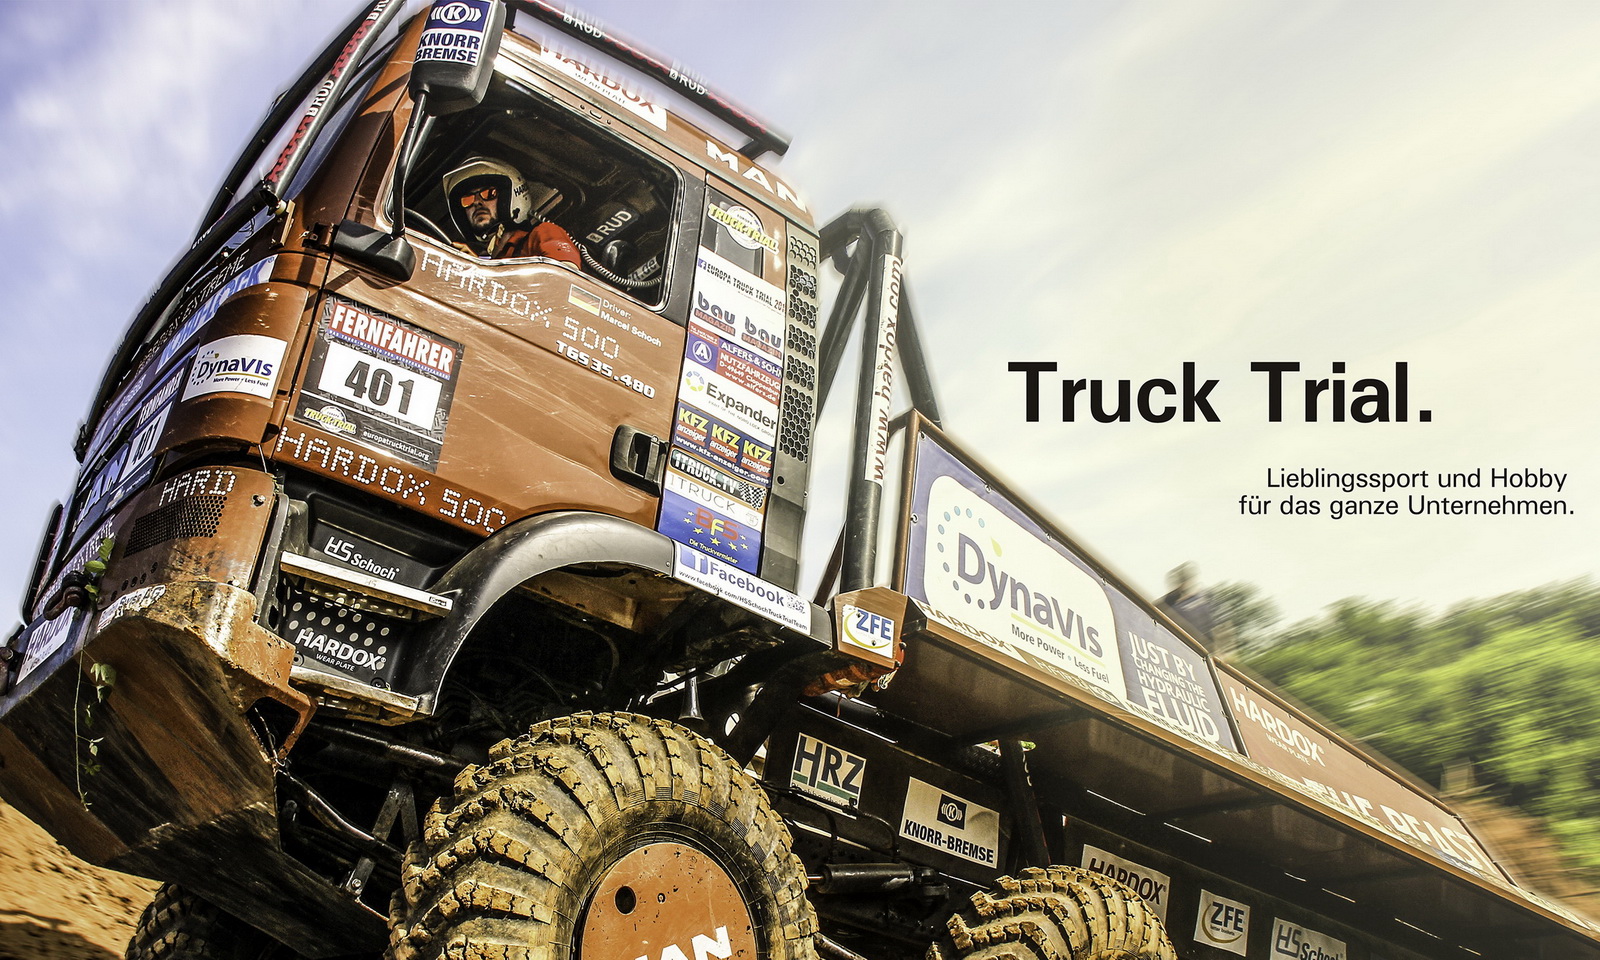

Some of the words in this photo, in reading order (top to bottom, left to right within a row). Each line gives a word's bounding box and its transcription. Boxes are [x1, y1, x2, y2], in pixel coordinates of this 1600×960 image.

[415, 48, 478, 63] BREMSE
[419, 33, 481, 50] KNORR
[313, 79, 335, 108] RUD
[678, 73, 705, 95] RUD
[705, 139, 807, 214] MAN
[596, 210, 632, 236] RUD
[420, 250, 553, 329] HARDOX
[562, 316, 620, 360] 500
[602, 299, 632, 319] Driver:
[694, 307, 736, 337] MAGAZIN
[698, 291, 736, 325] bau
[331, 304, 454, 374] FERNFAHRER
[600, 310, 630, 331] Marcel
[631, 326, 662, 347] Schoch
[741, 332, 782, 360] MAGAZIN
[744, 316, 782, 349] bau
[197, 357, 274, 381] DynaVIS
[721, 341, 753, 364] ALFERS
[344, 360, 415, 416] 401
[586, 357, 656, 399] 35.480
[304, 408, 357, 434] TRUCK-TRIAL
[678, 407, 710, 433] KFZ
[706, 382, 777, 430] Expander
[362, 430, 430, 461] europatrucktrial.org
[677, 423, 707, 443] anzeiger
[709, 439, 738, 459] anzeiger
[711, 423, 742, 450] KFZ
[275, 426, 432, 506] HARDOX
[675, 435, 770, 484] www.kfz-anzeiger.com
[741, 456, 771, 474] anzeiger
[743, 439, 773, 465] KFZ
[158, 469, 236, 507] HARD
[694, 506, 739, 541] BFS
[323, 535, 355, 562] HS
[350, 552, 399, 581] Schoch
[688, 538, 699, 547] Die
[699, 542, 739, 564] Truckvermieter
[710, 562, 785, 607] Facebook
[957, 532, 1104, 658] DynaVIS
[856, 609, 892, 641] ZFE
[295, 628, 383, 671] HARDOX
[316, 652, 337, 667] WEAR
[336, 659, 356, 673] PLATE
[1011, 623, 1035, 646] More
[1037, 638, 1066, 660] Power
[1073, 656, 1091, 675] Less
[1091, 666, 1110, 685] Fuel
[1128, 630, 1170, 669] JUST
[1172, 654, 1197, 682] BY
[1134, 657, 1186, 689] CHANGING
[1187, 681, 1206, 698] THE
[1137, 669, 1211, 713] HYDRAULIC
[1141, 685, 1220, 744] FLUID
[1228, 686, 1325, 767] HARDOX
[794, 736, 866, 795] HRZ
[1265, 731, 1289, 753] WEAR
[1289, 748, 1311, 767] PLATE
[904, 819, 995, 864] KNORR-BREMSE
[1380, 804, 1498, 875] BEAST
[1210, 901, 1245, 933] ZFE
[634, 925, 733, 960] AN
